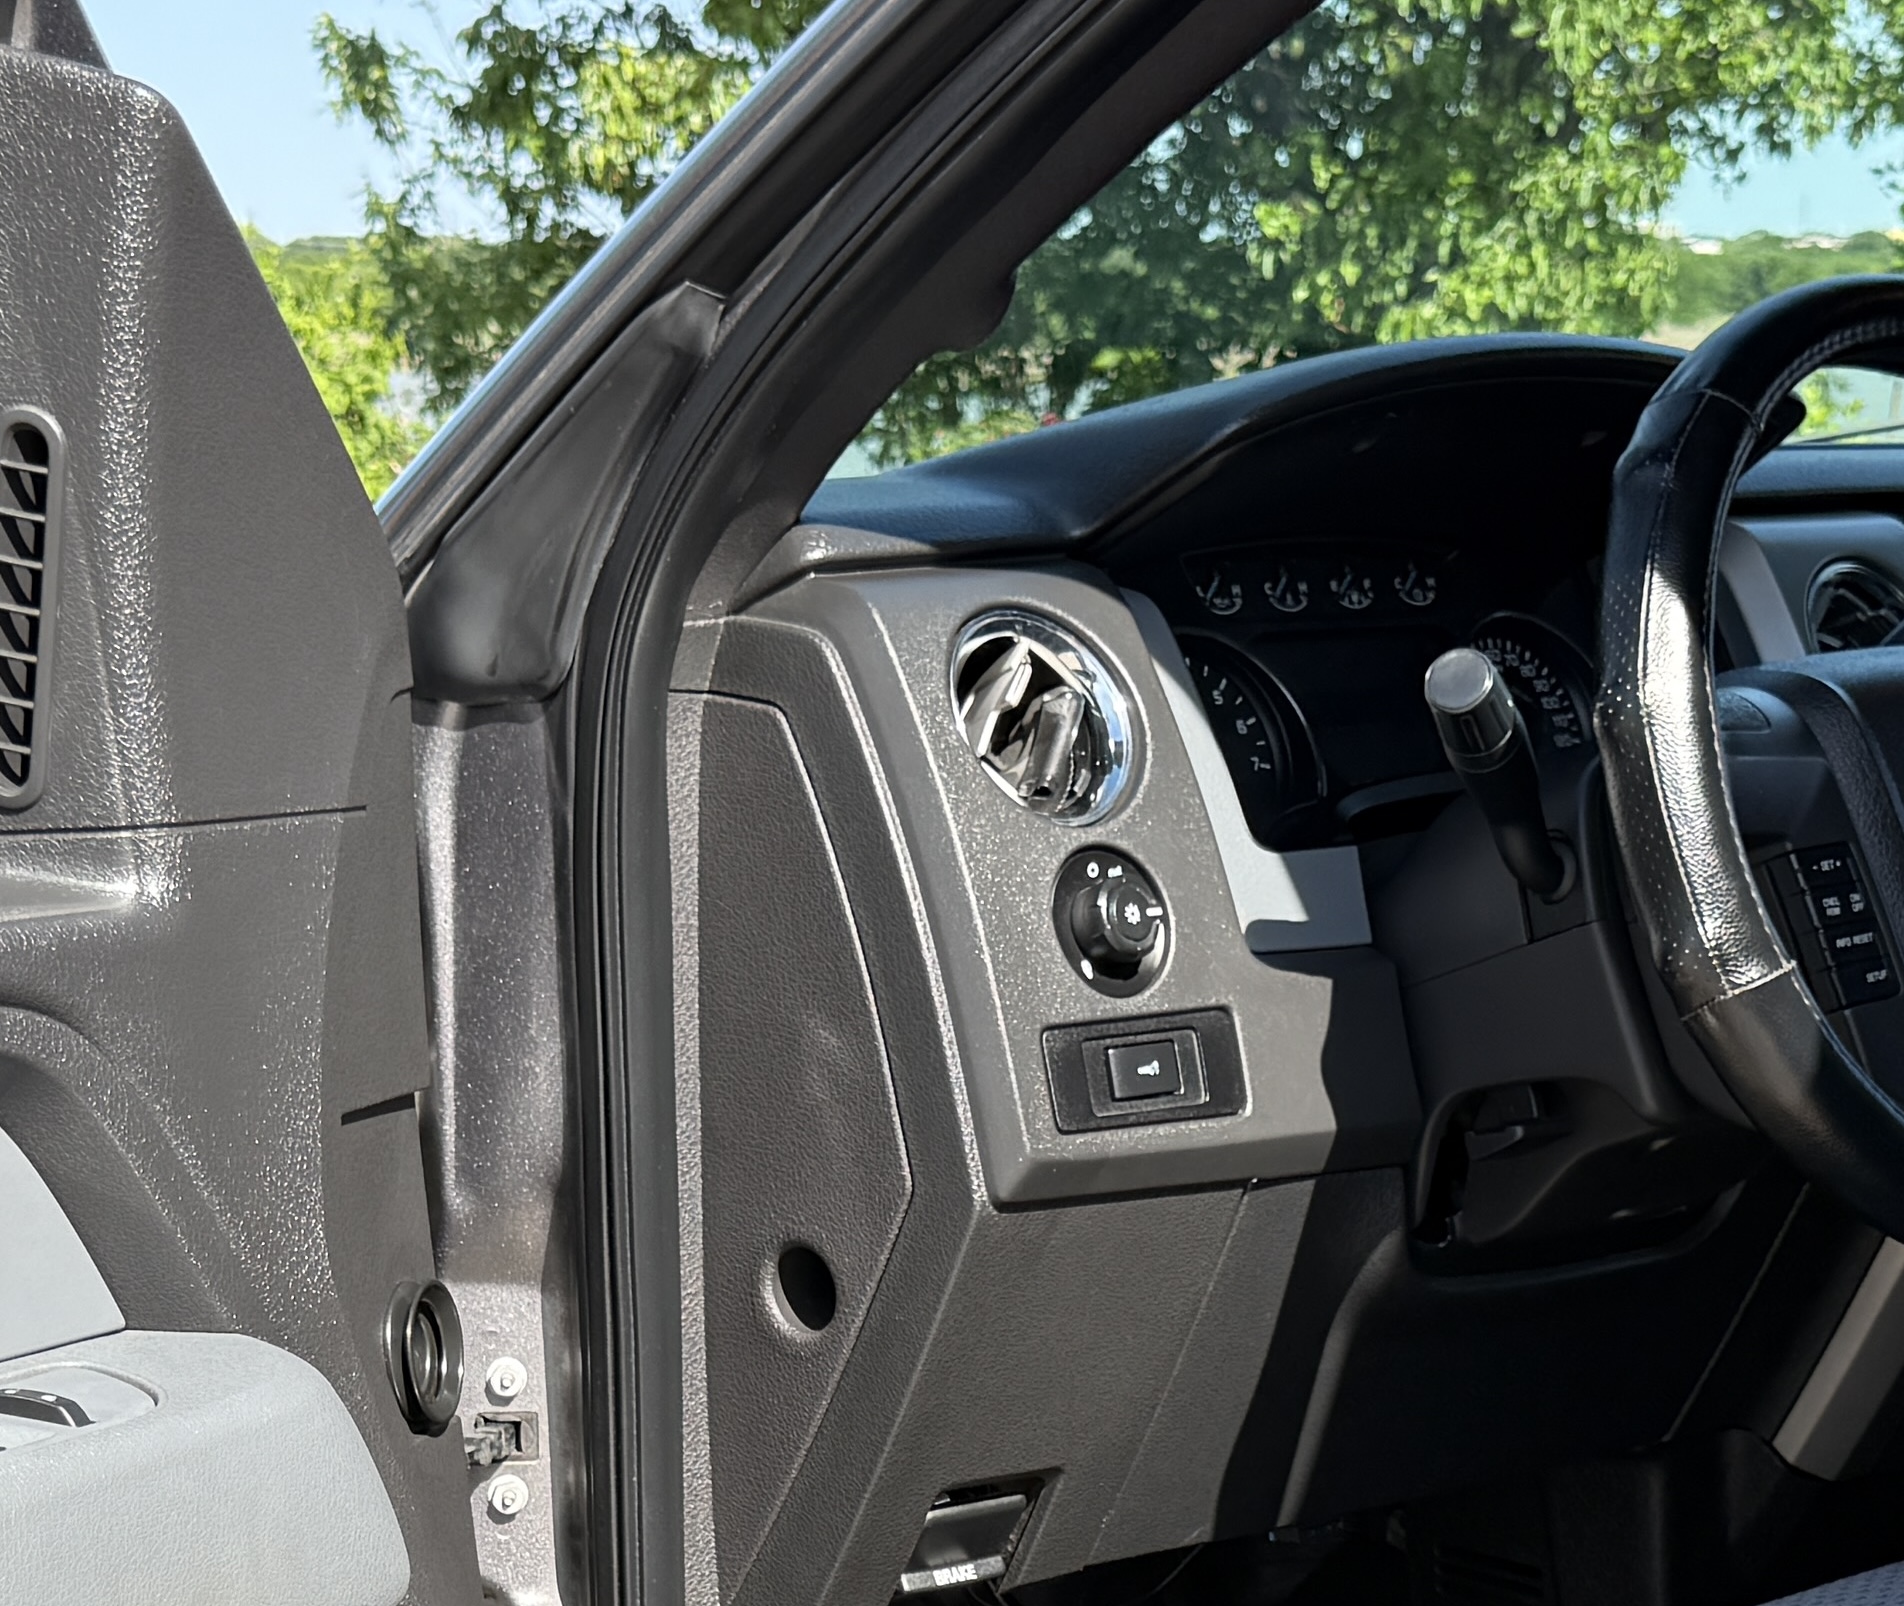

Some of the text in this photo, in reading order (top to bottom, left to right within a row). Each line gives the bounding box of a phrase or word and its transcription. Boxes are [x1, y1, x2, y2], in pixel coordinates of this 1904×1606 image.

[1212, 689, 1224, 705] 5
[1236, 719, 1248, 735] 6
[1250, 755, 1260, 772] 7
[932, 1563, 978, 1587] BRAKE
